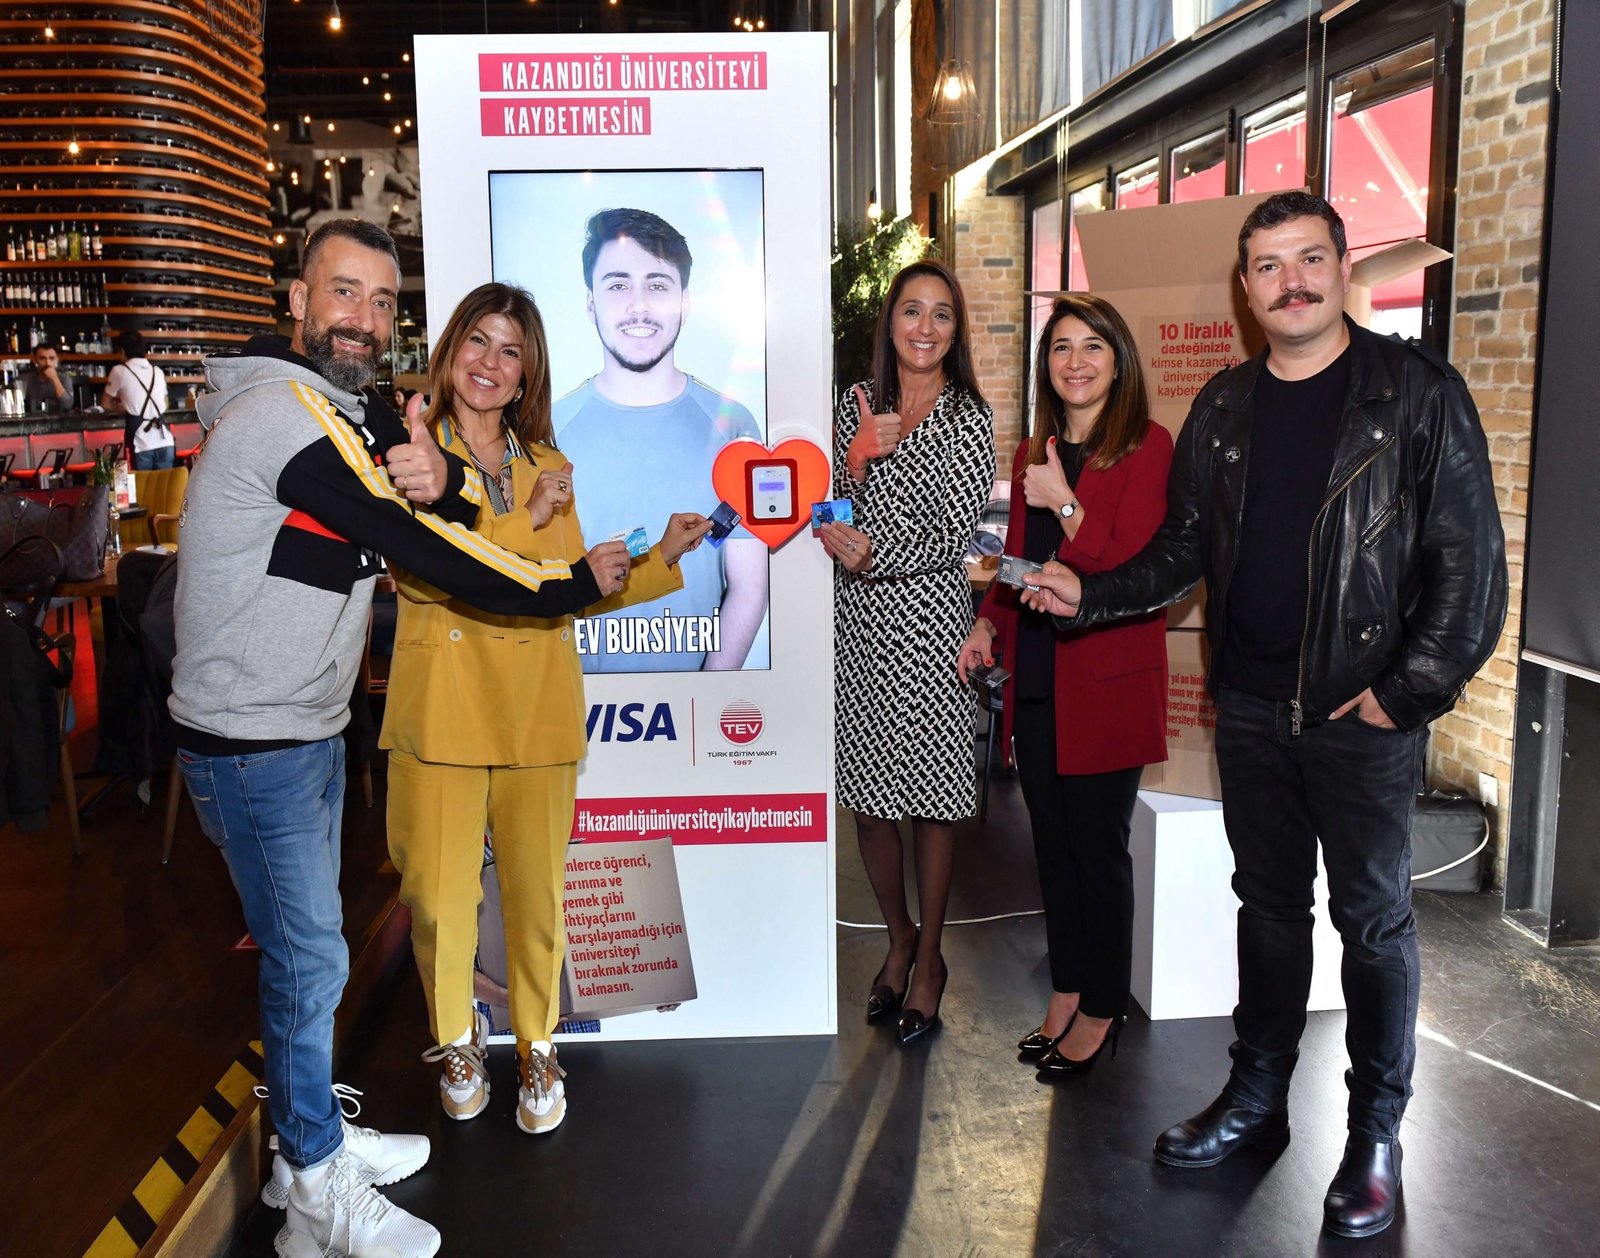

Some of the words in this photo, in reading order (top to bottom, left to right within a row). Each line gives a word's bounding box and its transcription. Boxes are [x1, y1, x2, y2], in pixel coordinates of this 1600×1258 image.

[502, 55, 612, 90] KAZANDIĞI
[621, 54, 760, 89] ÜNİVERSİTEYİ
[504, 99, 644, 135] KAYBETMESİN
[1160, 323, 1179, 340] 10
[1184, 321, 1234, 340] liralık
[1161, 341, 1231, 355] desteğinizle
[1151, 357, 1183, 368] kimse
[1186, 356, 1241, 369] kazandığı
[605, 607, 721, 655] BURSİYERİ
[586, 702, 677, 742] VISA
[723, 722, 760, 735] TEV
[578, 805, 813, 836] #kazandığıüniversiteyikaybetmesin
[564, 858, 602, 872] nlerce
[603, 855, 651, 873] öğrenci,
[564, 878, 607, 891] arınma
[608, 876, 623, 887] ve
[562, 893, 600, 914] yemek
[601, 891, 625, 910] gibi
[564, 910, 636, 929] ihtiyaçlarını
[567, 924, 660, 945] karşılayamadığı
[660, 922, 682, 939] için
[571, 943, 641, 963] üniversiteyi
[574, 960, 630, 980] bırakmak
[632, 957, 678, 974] zorunda
[577, 981, 634, 998] kalmasın.
